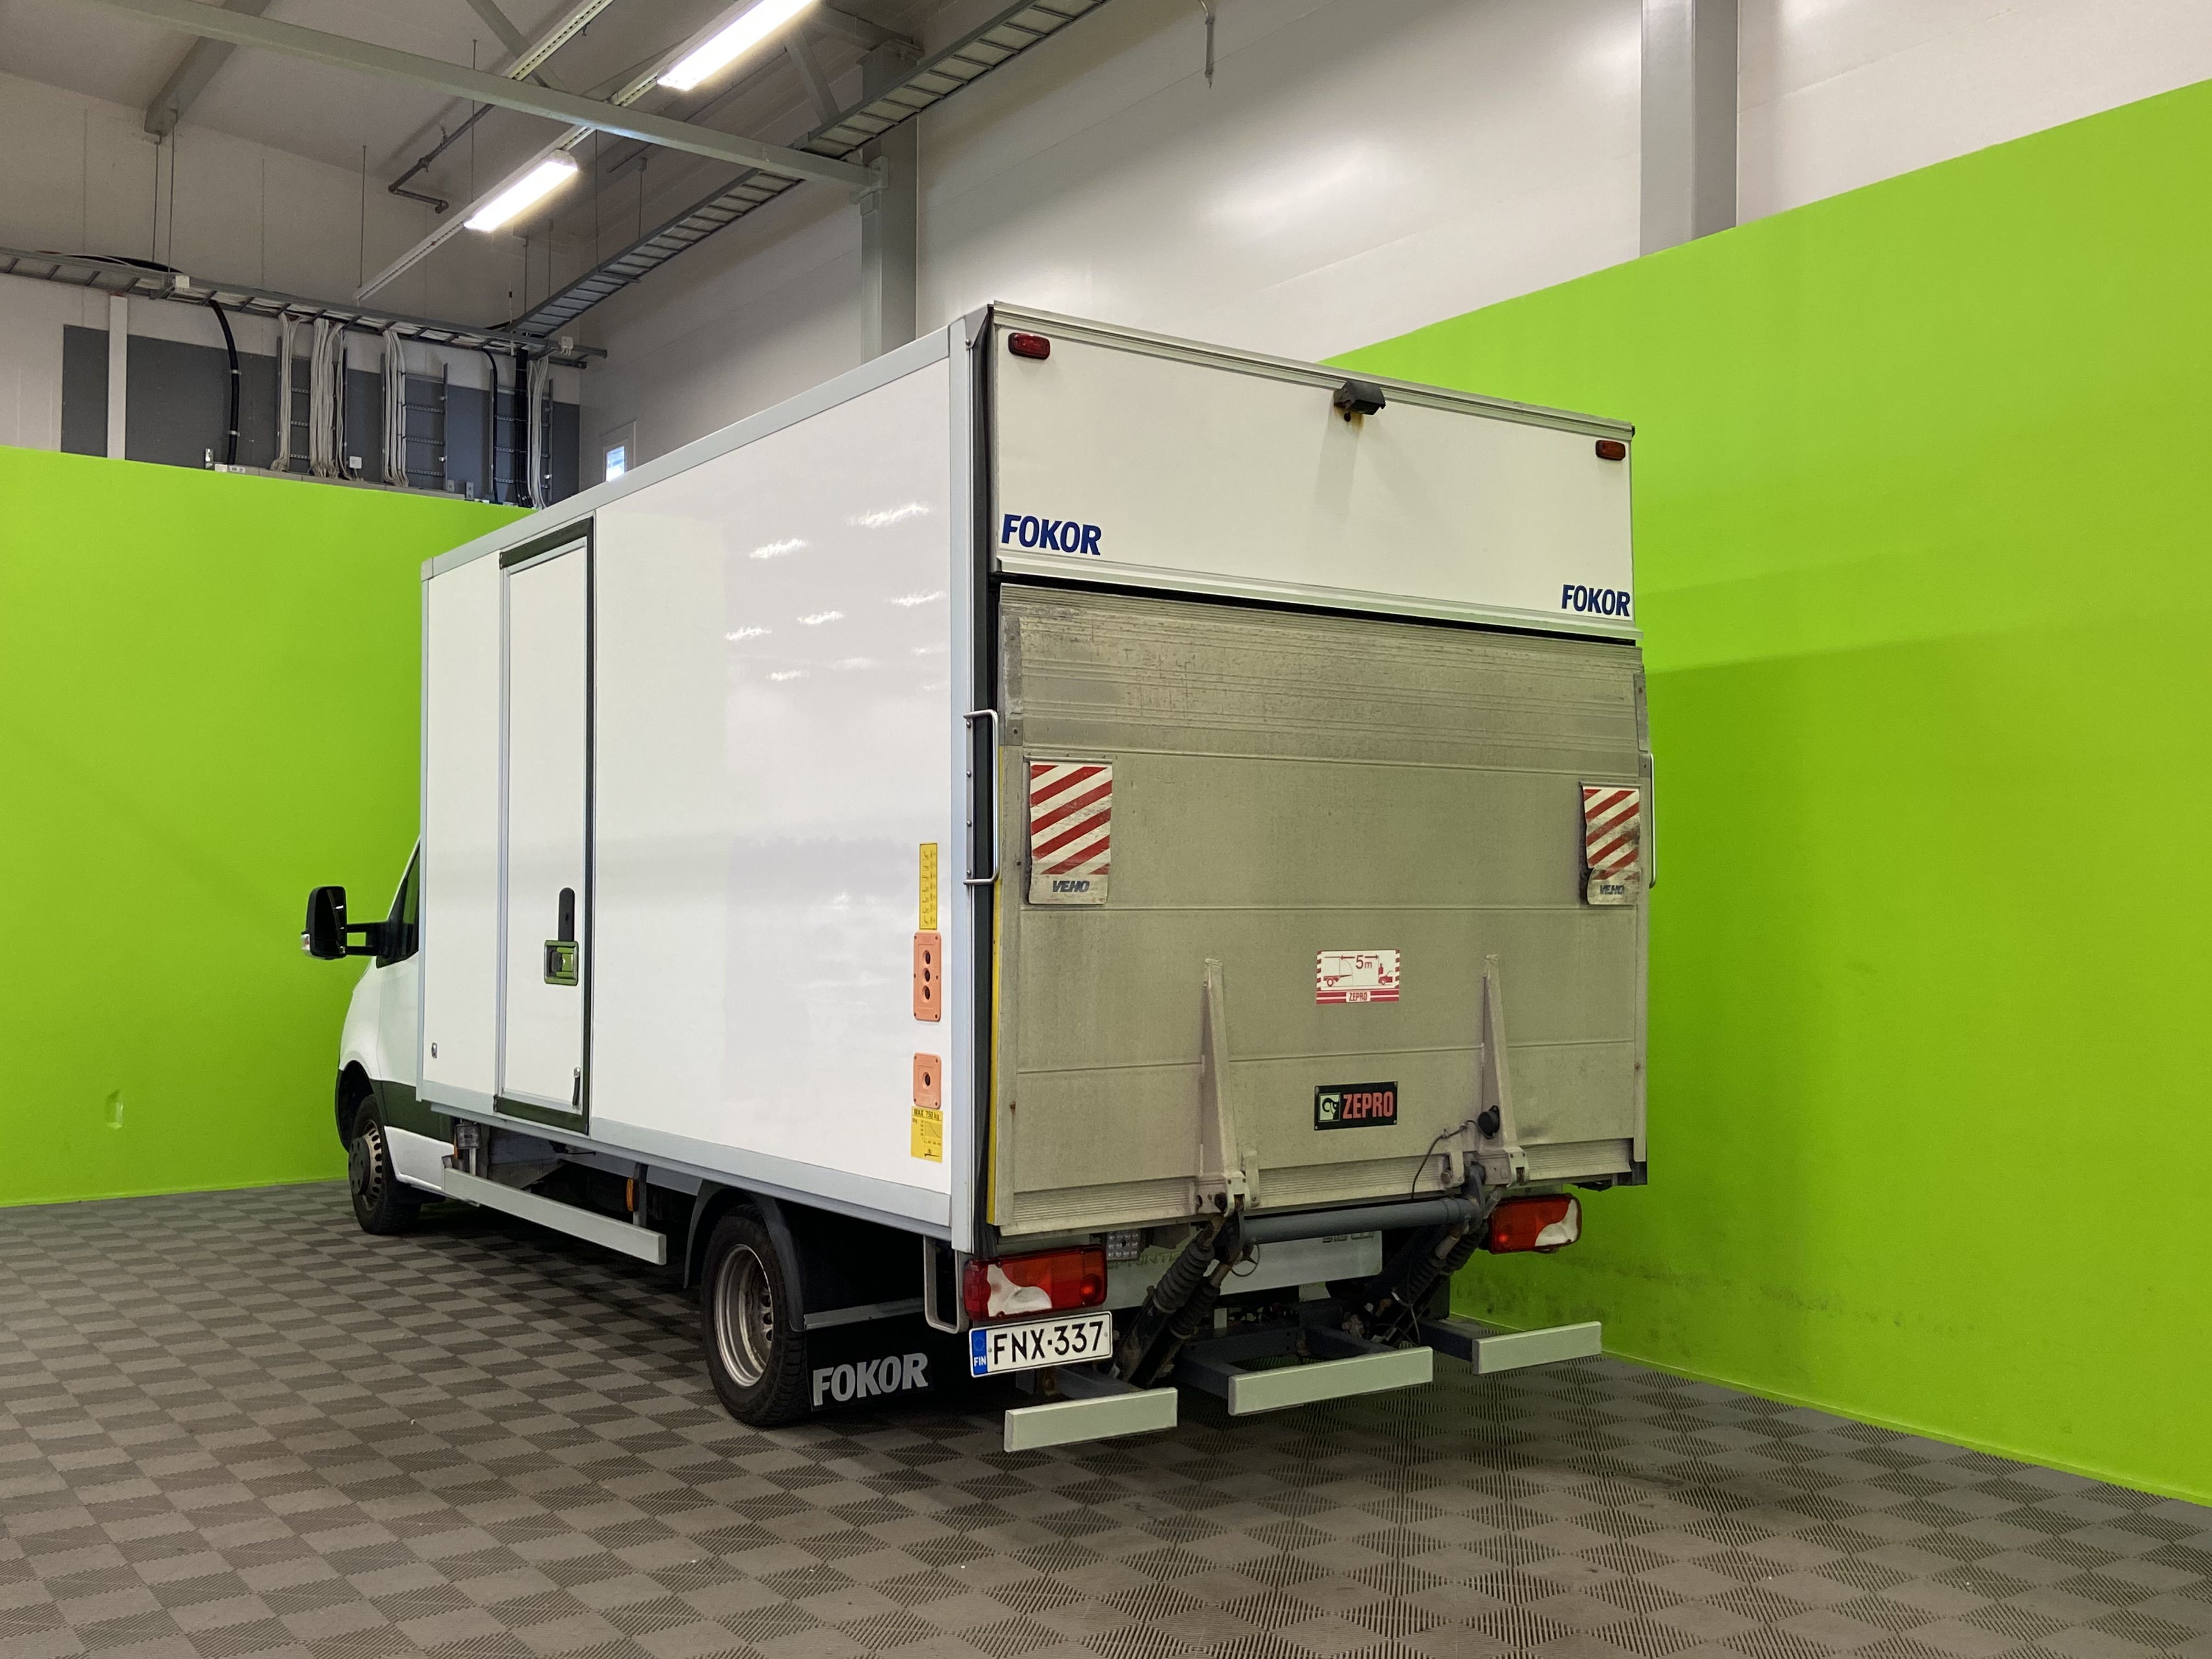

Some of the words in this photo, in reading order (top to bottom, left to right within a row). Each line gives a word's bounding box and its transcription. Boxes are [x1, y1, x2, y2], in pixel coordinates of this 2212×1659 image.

[1001, 514, 1102, 556] FOKOR
[1561, 584, 1630, 617] FOKOR
[1052, 880, 1090, 893] VEHO
[1599, 885, 1624, 895] VEHO
[1348, 991, 1368, 1001] ZEPRO
[1342, 1091, 1393, 1119] ZEPRO
[994, 1321, 1104, 1365] FNX-337
[973, 1356, 986, 1367] FIN
[813, 1352, 928, 1406] FOKOR
